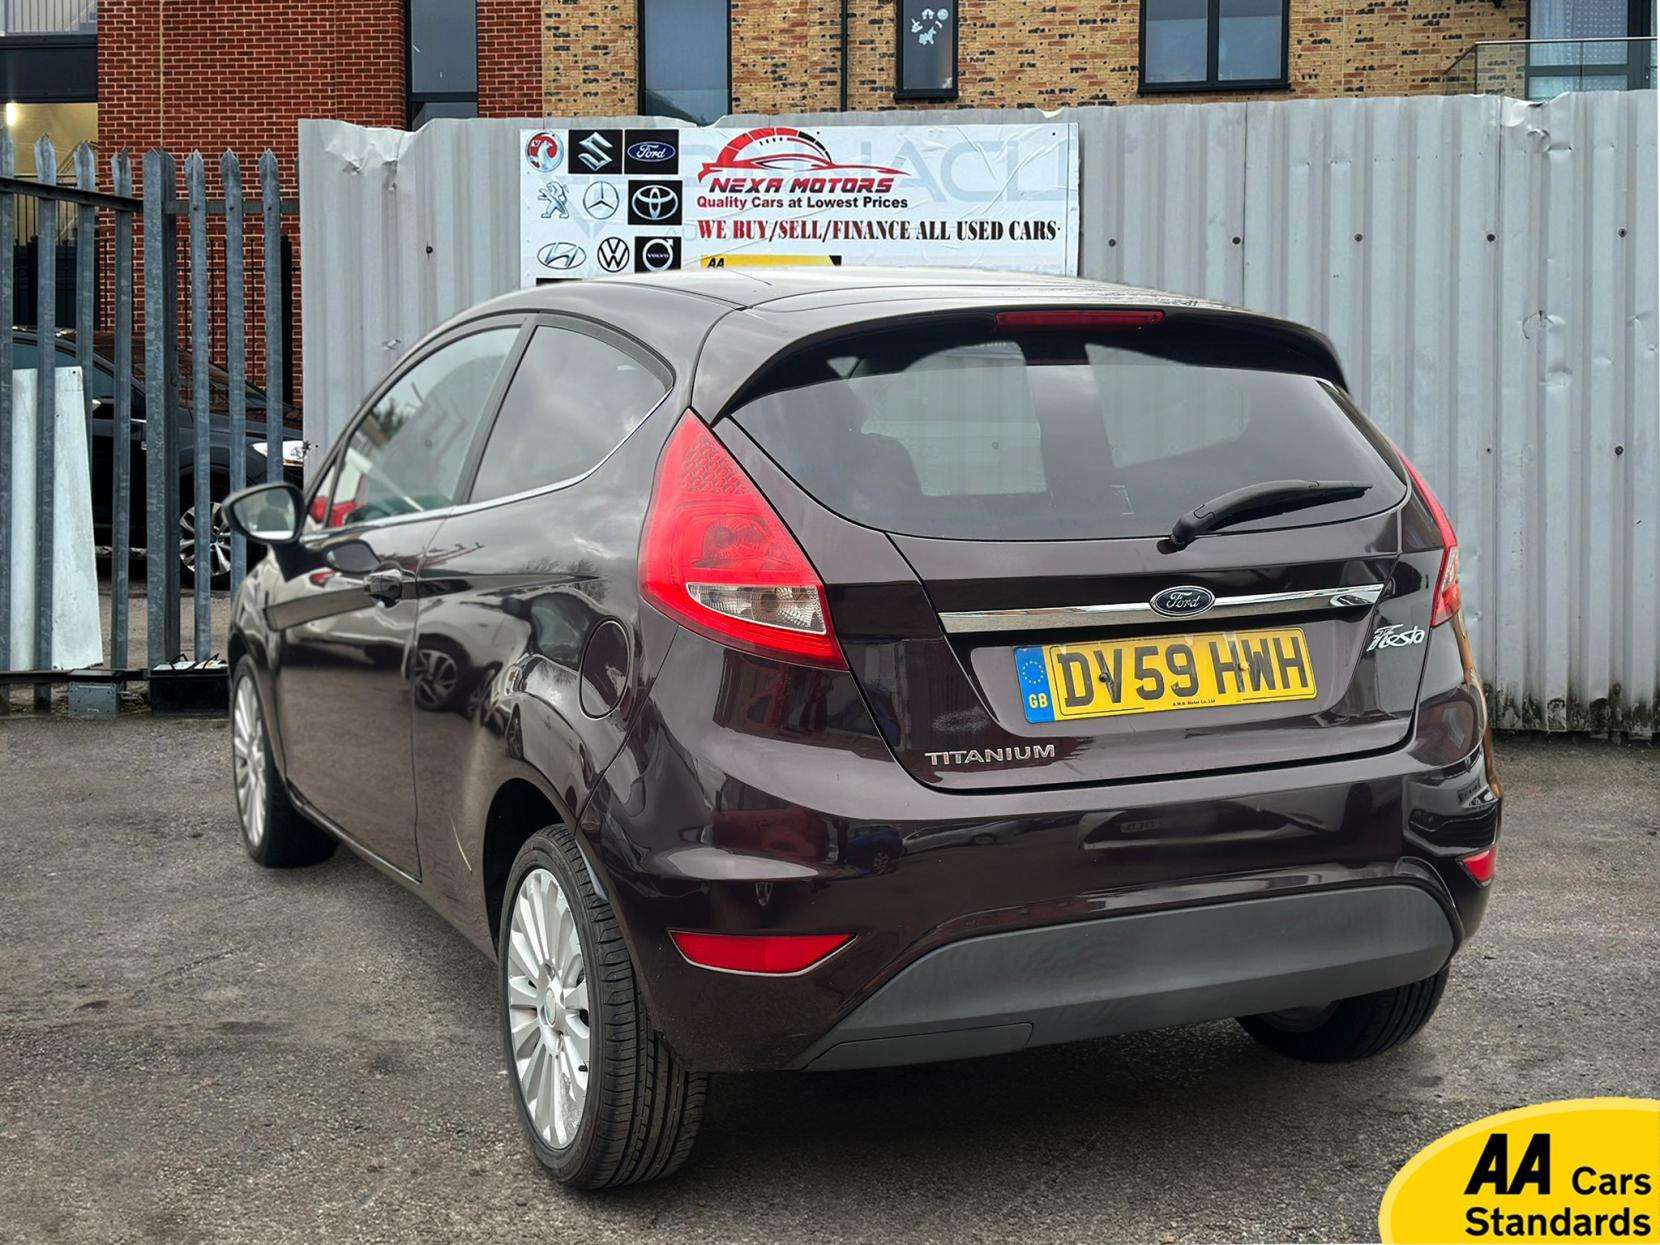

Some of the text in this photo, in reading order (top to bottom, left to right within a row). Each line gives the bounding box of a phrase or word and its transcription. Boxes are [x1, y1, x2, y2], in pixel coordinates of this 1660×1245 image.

[635, 144, 666, 159] Ford
[709, 178, 894, 193] NEXA MOTORS
[697, 196, 908, 211] Quality Cars at Lowest Prices
[697, 220, 727, 240] WE
[916, 220, 951, 240] ALL
[956, 220, 1004, 240] USED
[1008, 220, 1057, 240] CARS
[707, 257, 725, 268] AA
[1166, 591, 1201, 608] Ford
[1366, 623, 1426, 652] Fiesta
[1058, 635, 1310, 708] DV59 HWH
[1028, 692, 1049, 708] GB
[925, 743, 1056, 767] TITANIUM
